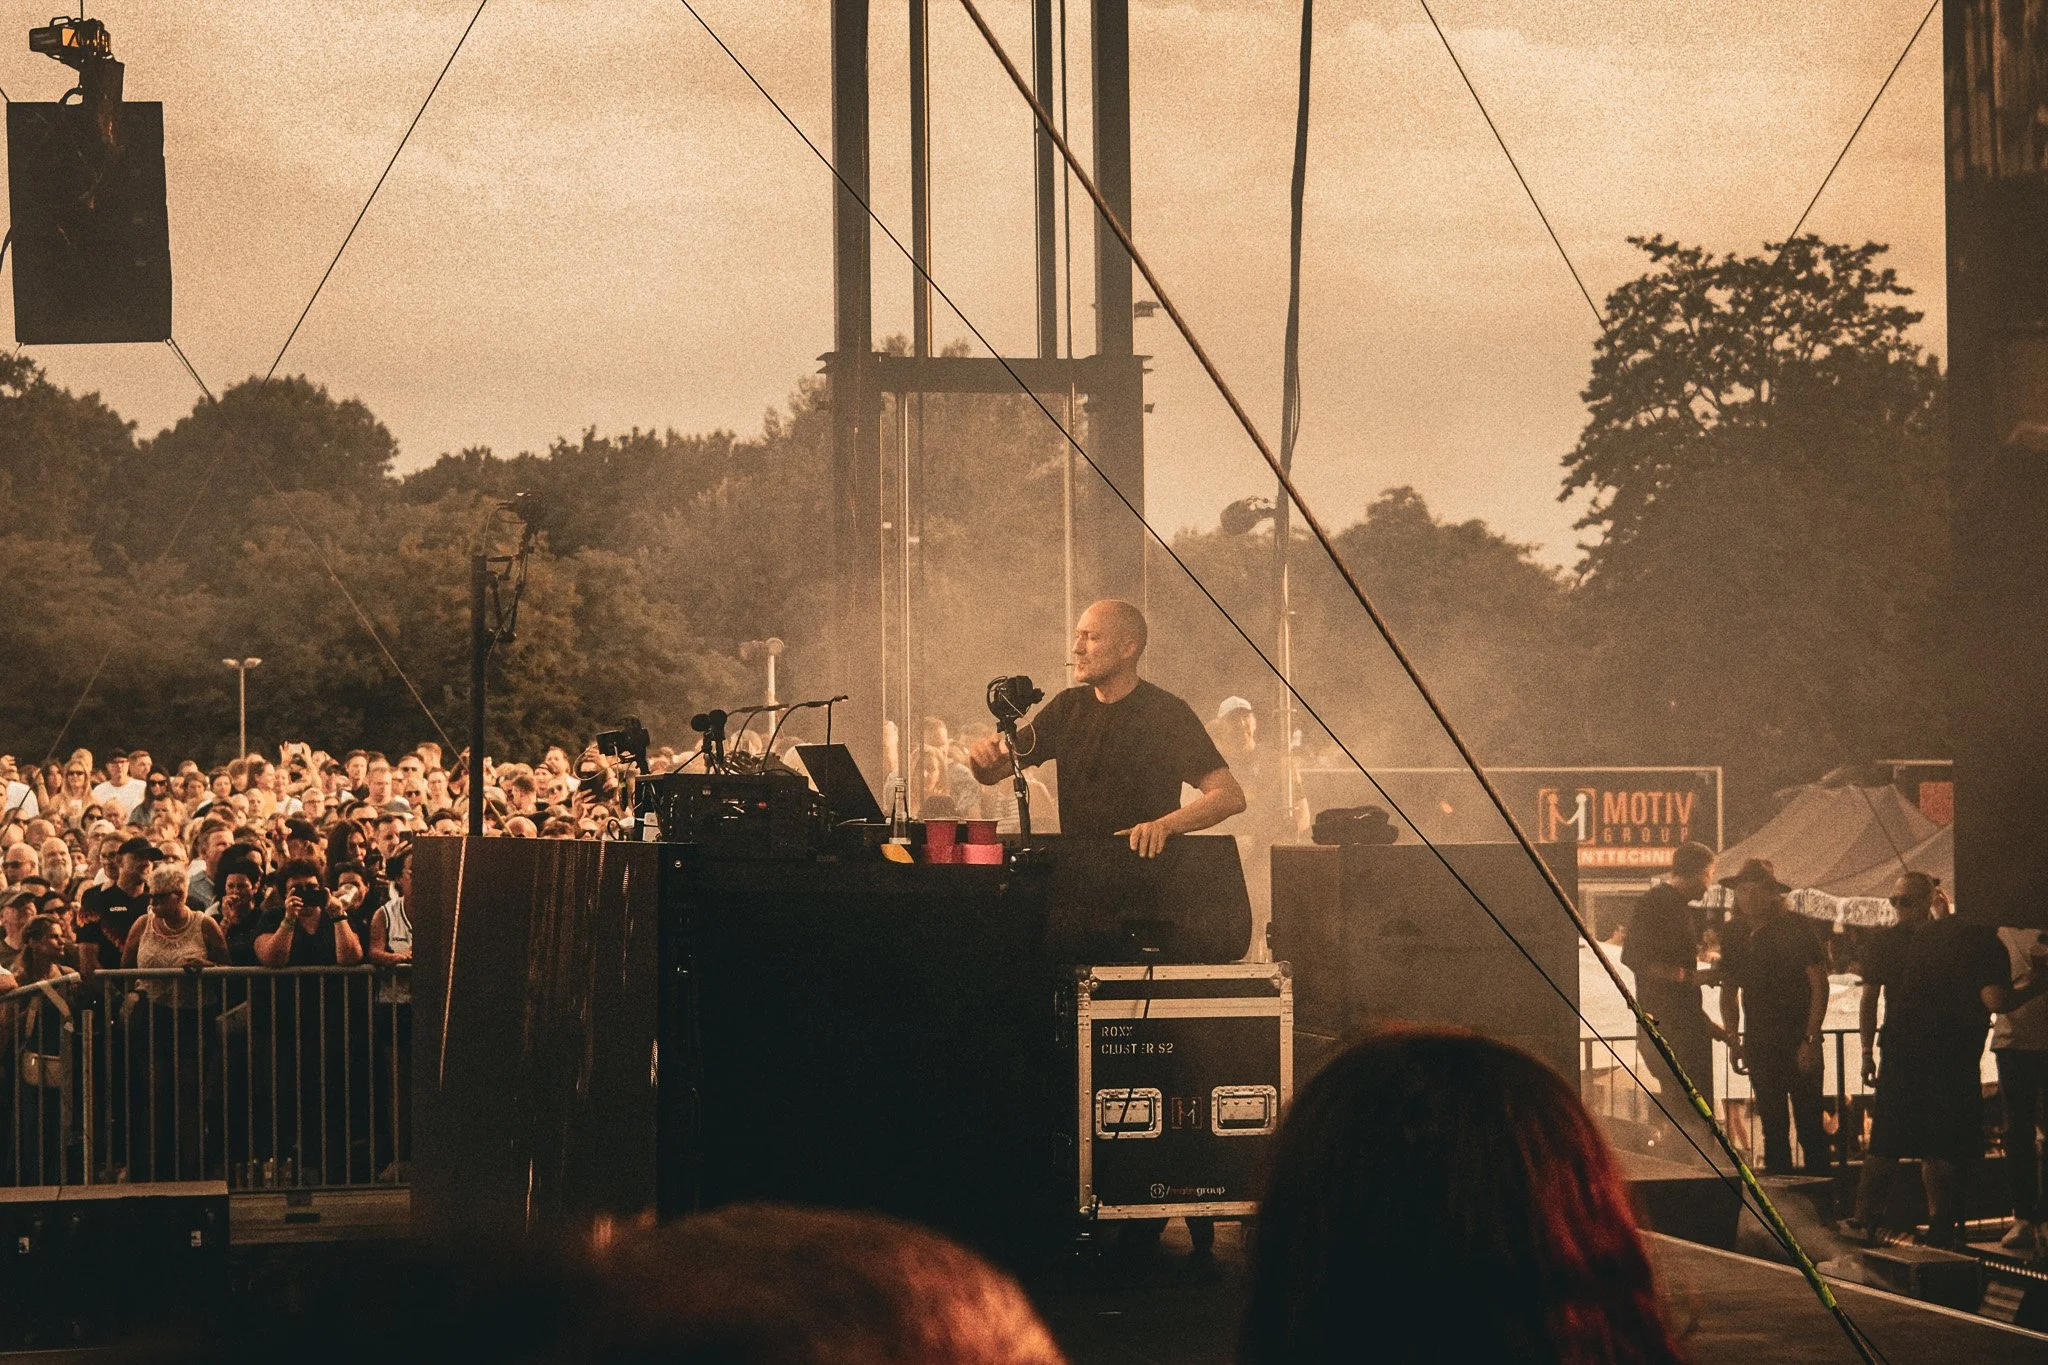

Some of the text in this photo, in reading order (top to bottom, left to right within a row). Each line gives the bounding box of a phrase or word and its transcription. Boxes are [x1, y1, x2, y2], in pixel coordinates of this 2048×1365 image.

[1602, 790, 1694, 825] MOTIV
[1603, 827, 1688, 843] GROUP
[1577, 849, 1673, 864] NTTECHNI
[1101, 1043, 1174, 1055] CLUSTER S2
